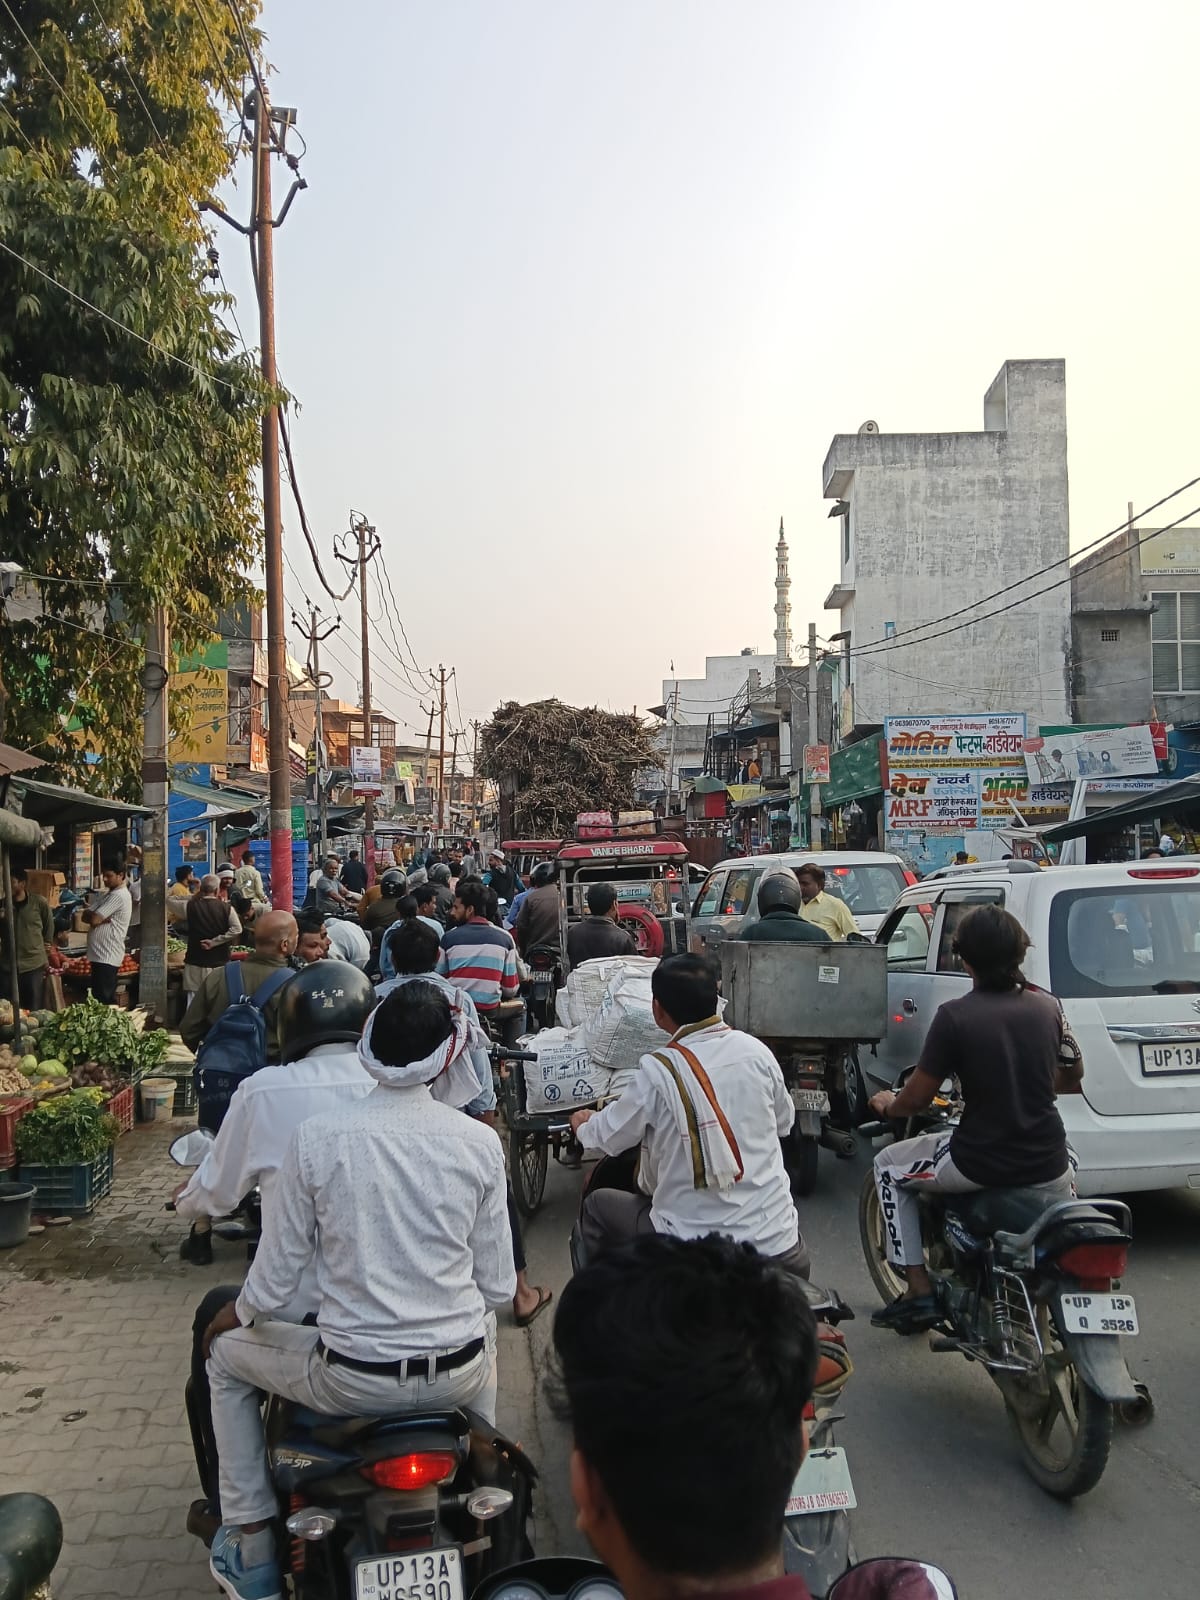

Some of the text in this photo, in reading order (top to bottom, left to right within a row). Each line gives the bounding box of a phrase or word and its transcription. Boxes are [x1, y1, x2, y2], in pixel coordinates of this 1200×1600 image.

[890, 732, 952, 756] मोहित
[890, 773, 971, 798] देव टायर्स
[888, 799, 933, 818] MRF
[590, 845, 655, 856] VANDE BHARAT
[1072, 1296, 1125, 1310] UP 13
[1100, 1318, 1134, 1332] 3526
[362, 1586, 376, 1594] IND
